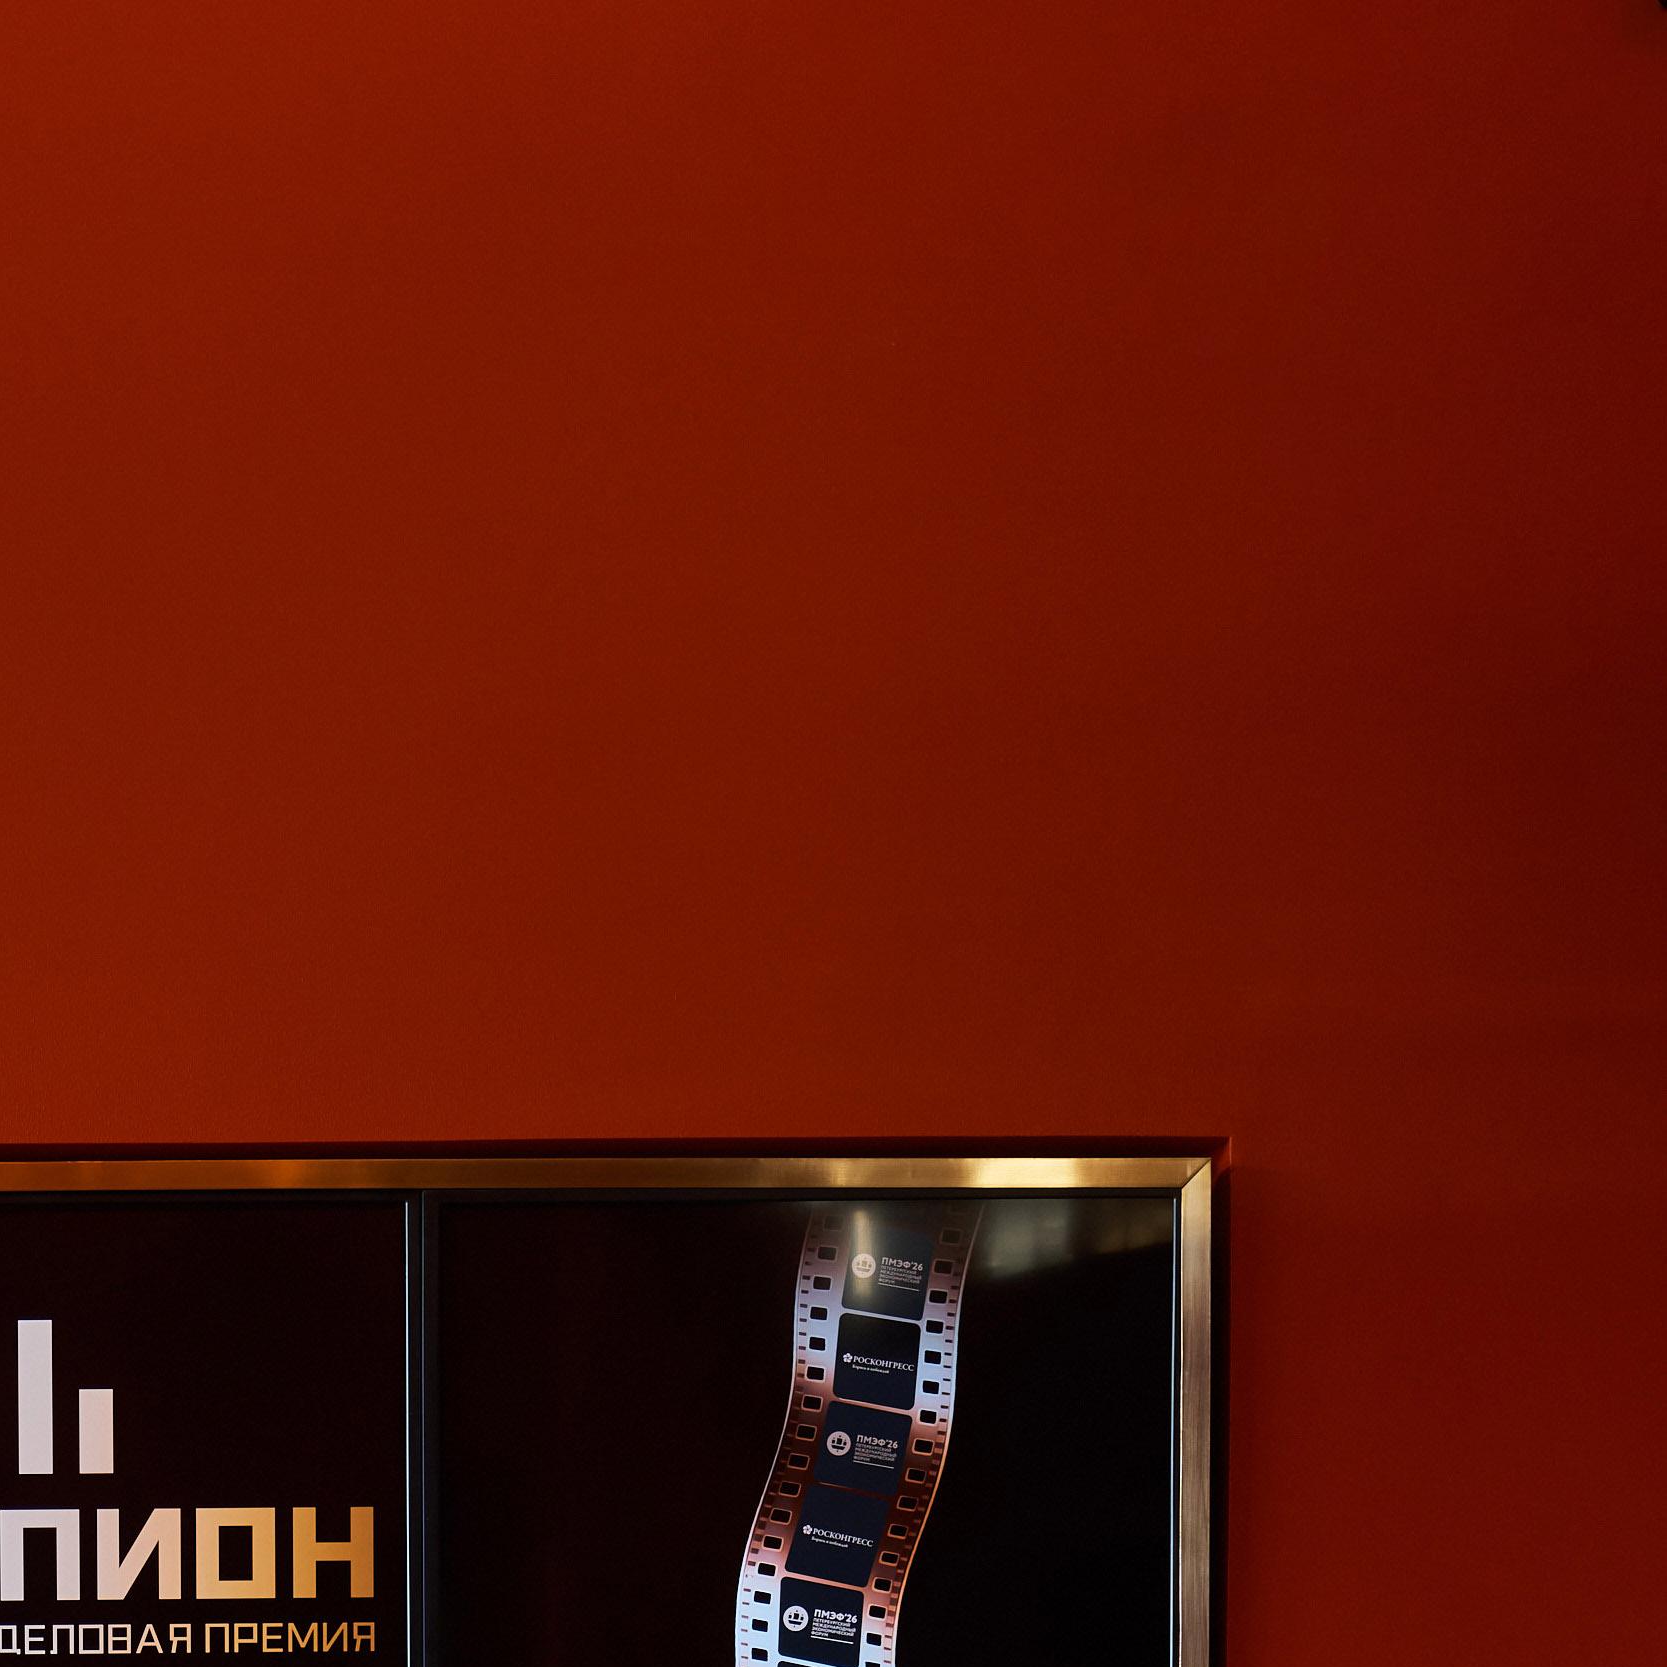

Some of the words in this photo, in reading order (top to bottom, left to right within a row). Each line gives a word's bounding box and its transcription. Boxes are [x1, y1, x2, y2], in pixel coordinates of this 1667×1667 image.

[853, 1355, 914, 1371] РОСКОНГРЕСС
[812, 1527, 874, 1547] РОСКОНГРЕСС
[204, 1621, 376, 1653] ПРЕМИЯ
